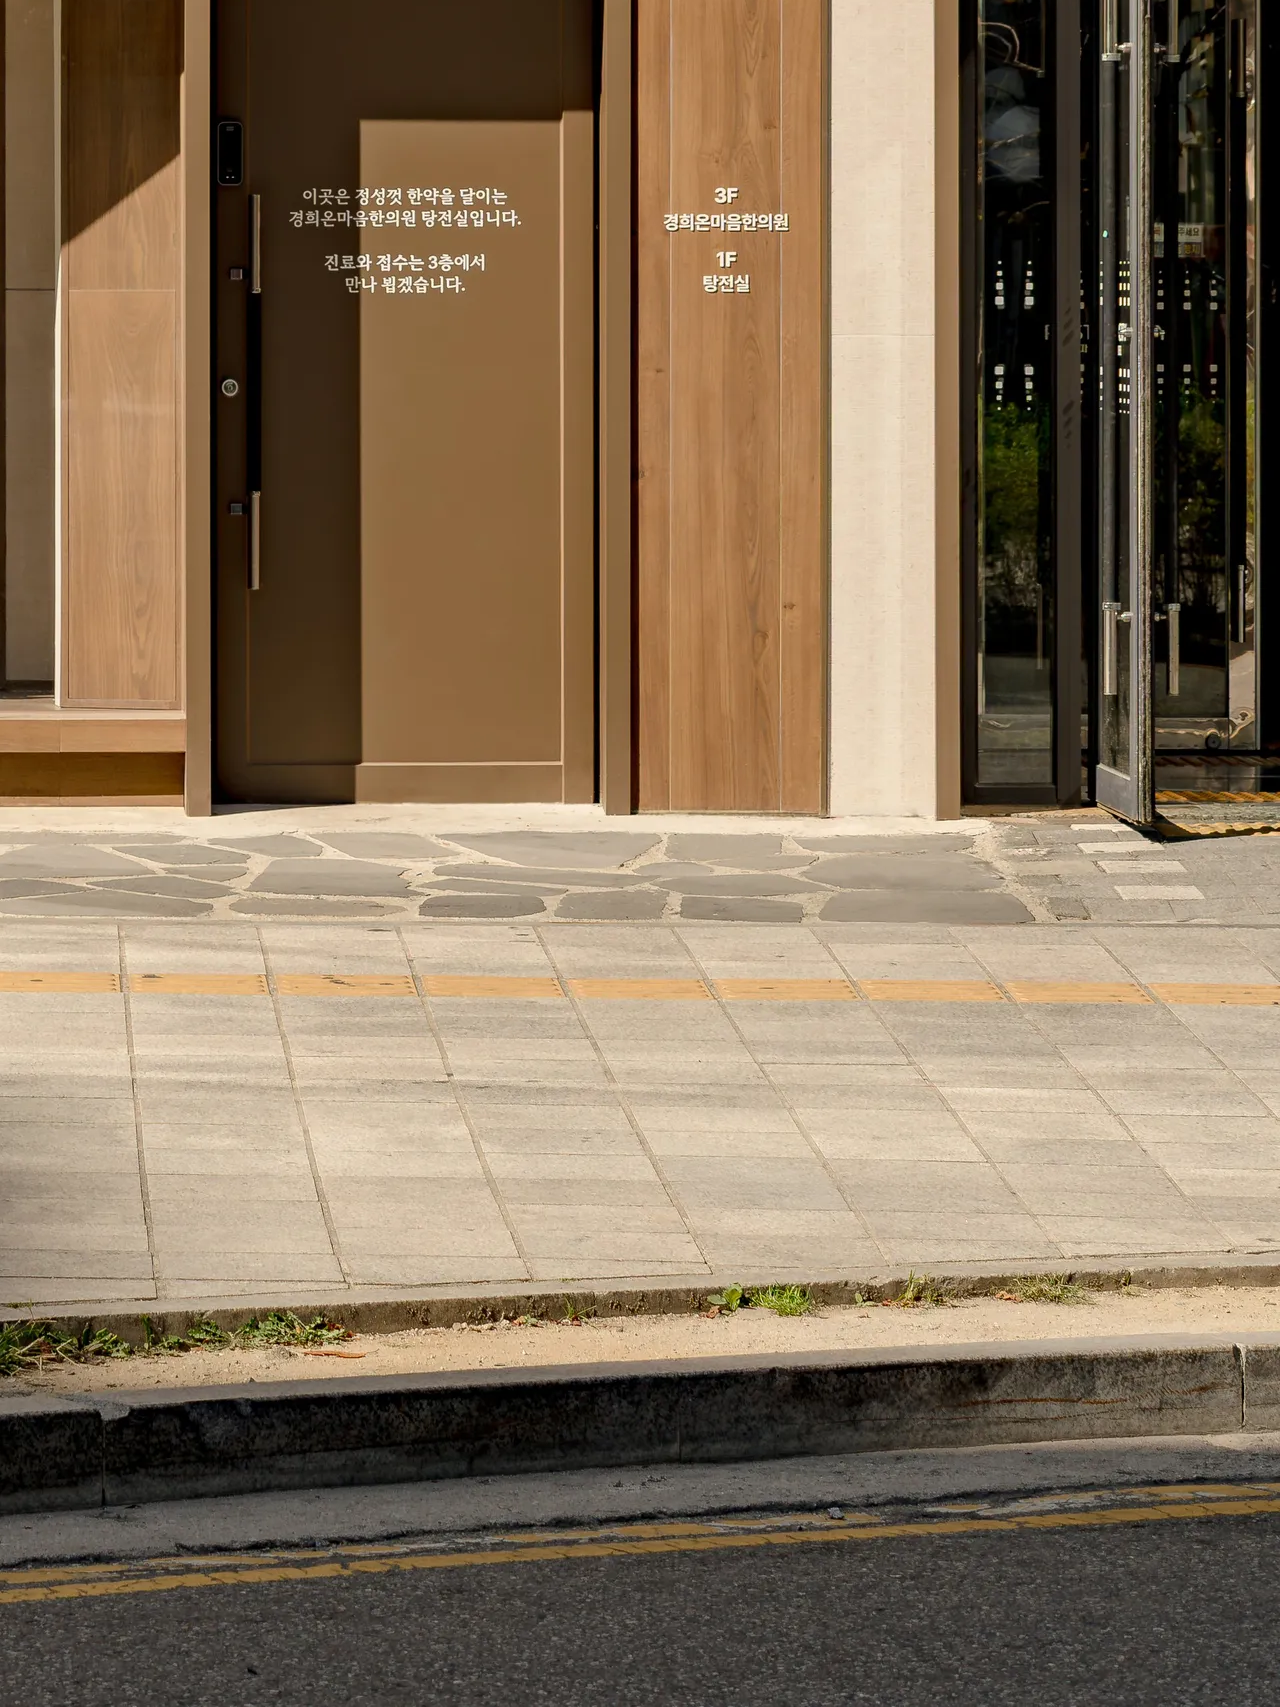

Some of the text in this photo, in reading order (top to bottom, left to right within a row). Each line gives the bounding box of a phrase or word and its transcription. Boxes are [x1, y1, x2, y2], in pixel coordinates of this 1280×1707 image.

[303, 188, 508, 206] 이곳은 정성껏 한약을 달이는
[714, 187, 738, 203] 3F
[289, 210, 522, 227] 경희온마음한의원 탕전실입니다.
[663, 213, 789, 231] 경희온마음한의원
[324, 254, 486, 271] 진료와 접수는 3층에서
[716, 251, 738, 268] 1F
[345, 276, 466, 294] 만나 뵙겠습니다.
[703, 274, 750, 293] 탕전실
